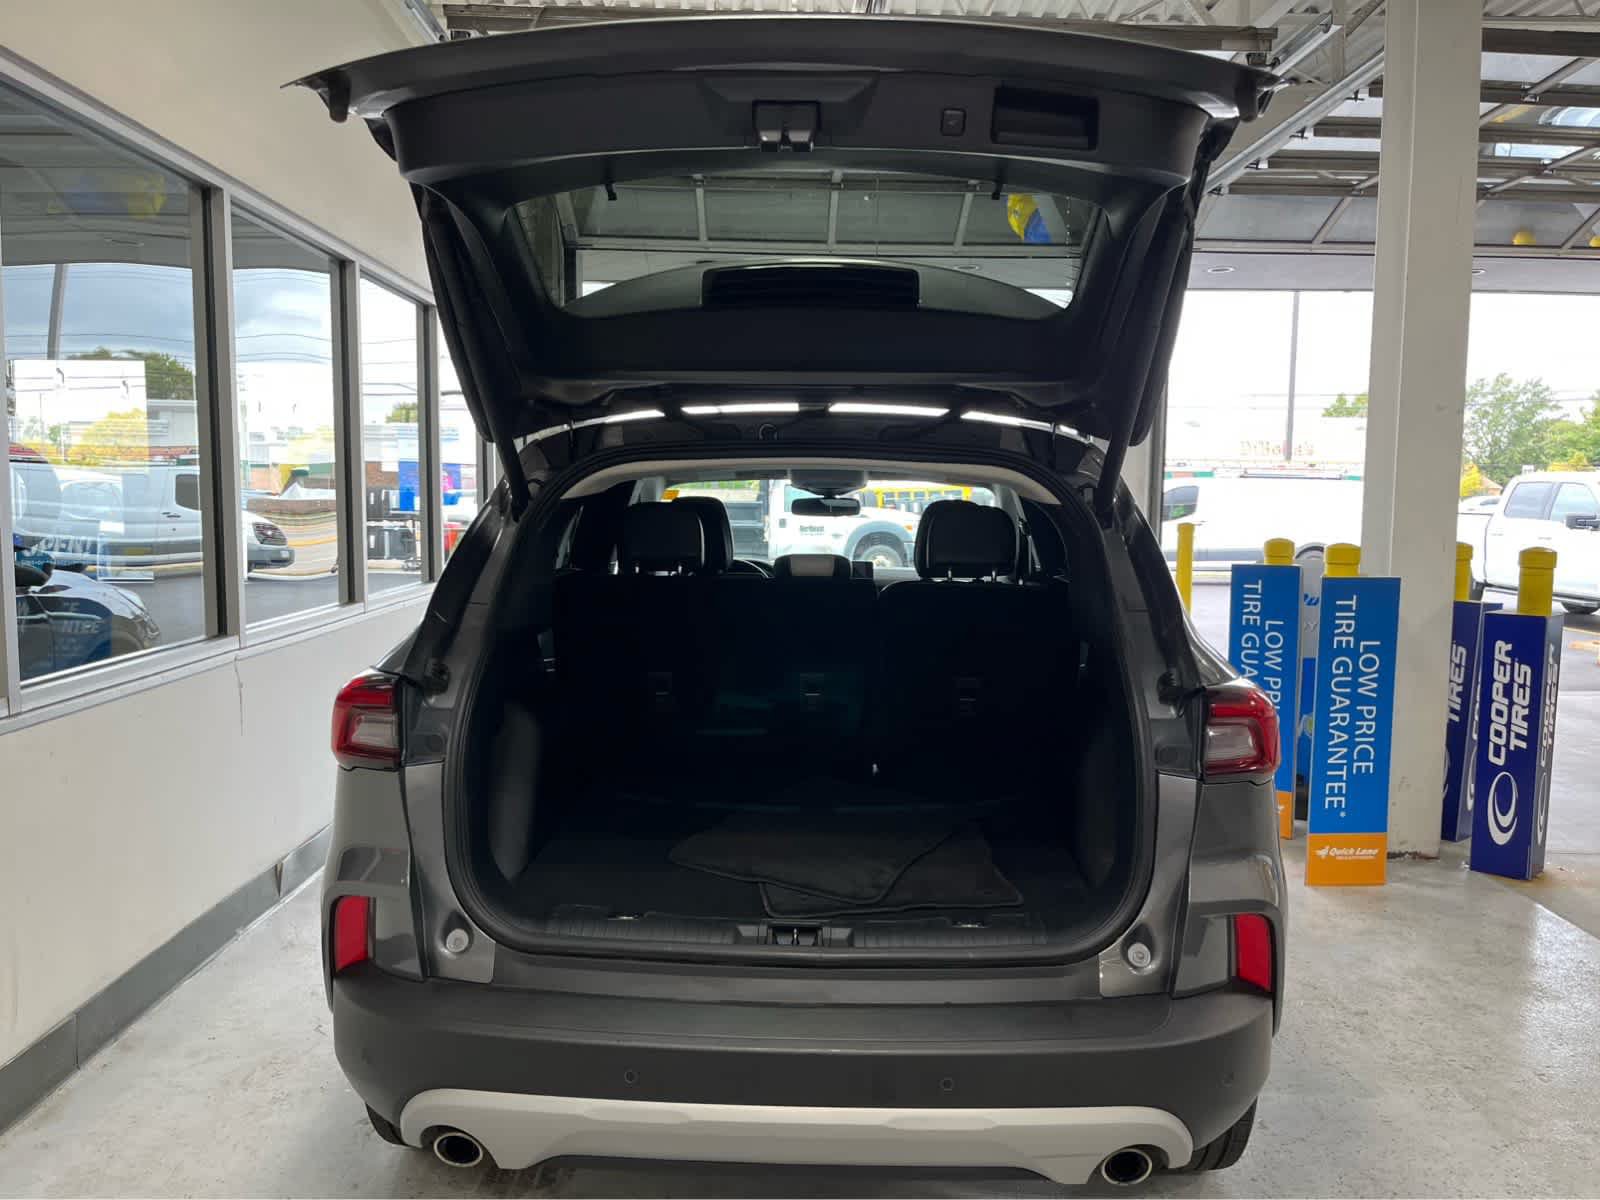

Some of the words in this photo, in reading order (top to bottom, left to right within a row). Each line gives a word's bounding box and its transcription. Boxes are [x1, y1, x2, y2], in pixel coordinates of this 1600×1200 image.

[1242, 579, 1263, 626] TIRE
[1332, 594, 1357, 649] TIRE
[1240, 632, 1260, 678] GUA
[1264, 620, 1285, 671] LOW
[1356, 641, 1381, 698] LOW
[1448, 644, 1467, 723] TIRES
[1488, 639, 1513, 767] COOPER
[1509, 662, 1532, 751] TIRES
[1352, 705, 1377, 775] PRICE
[1329, 847, 1354, 857] Quick
[1355, 847, 1380, 856] Lane
